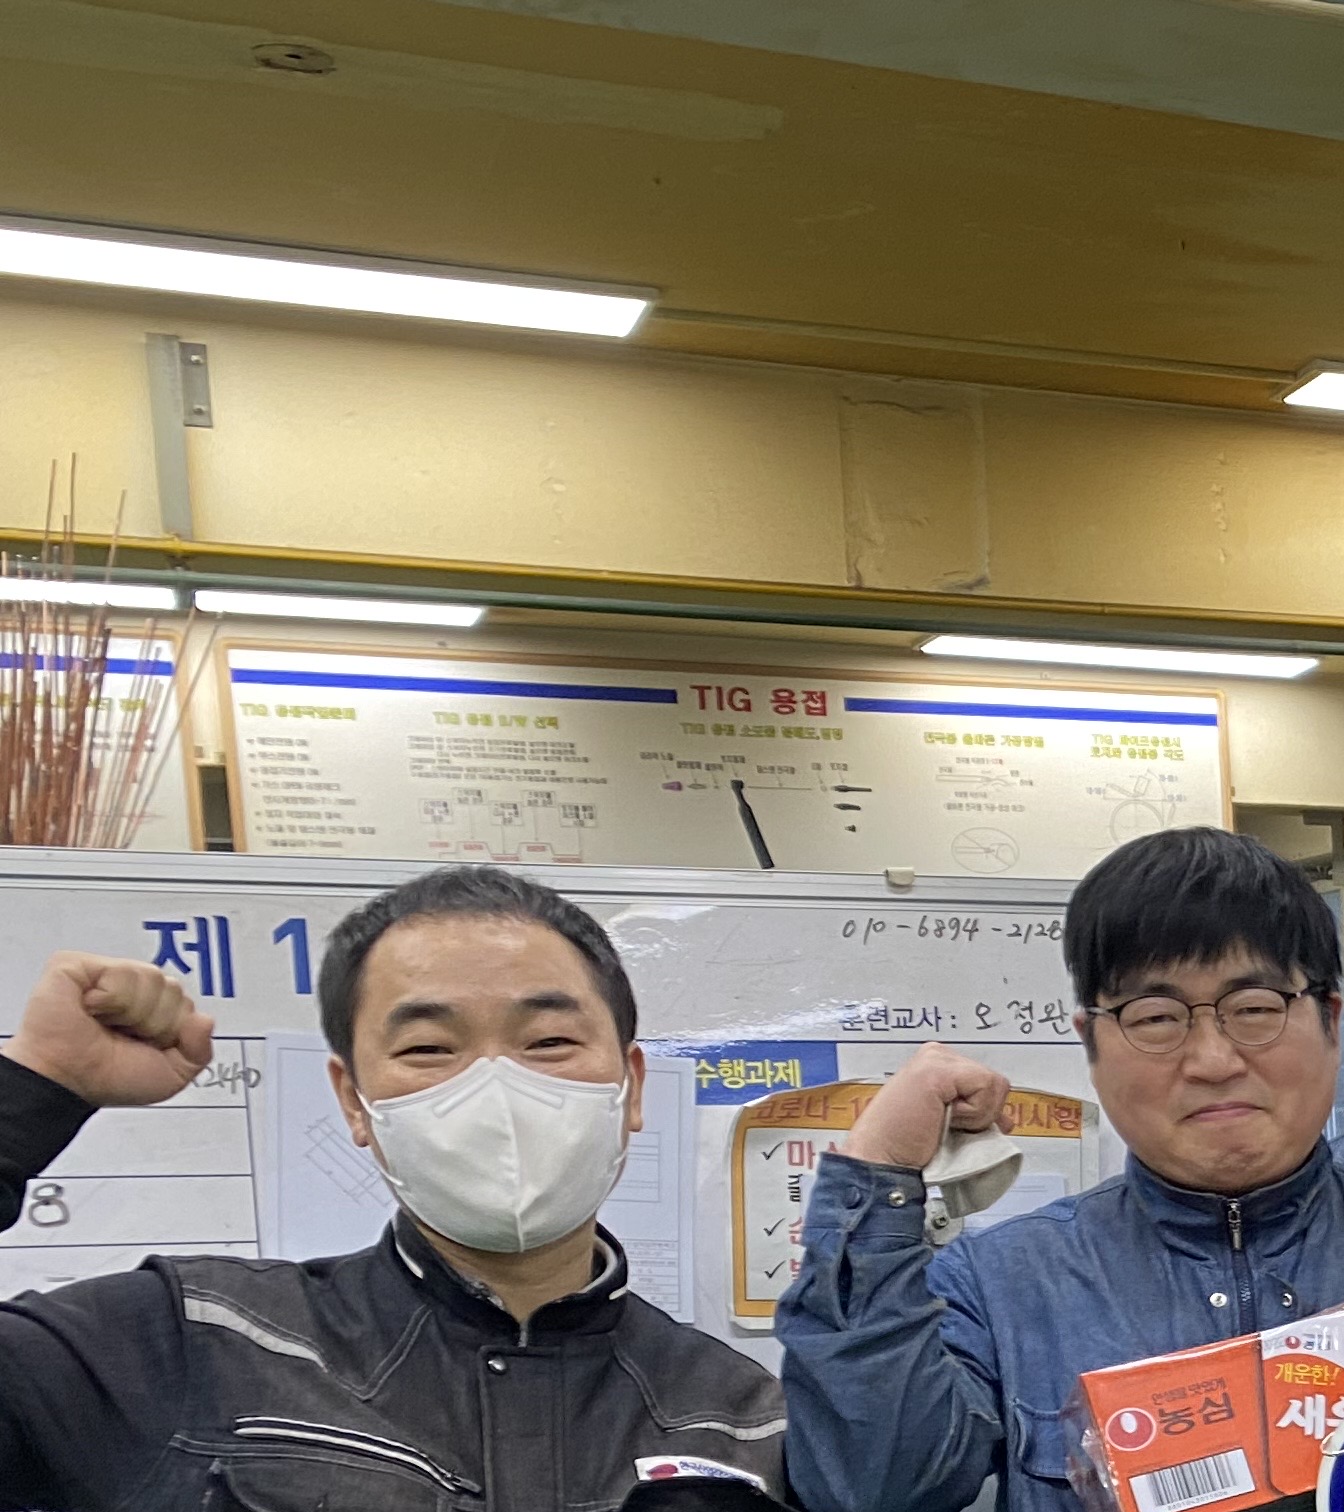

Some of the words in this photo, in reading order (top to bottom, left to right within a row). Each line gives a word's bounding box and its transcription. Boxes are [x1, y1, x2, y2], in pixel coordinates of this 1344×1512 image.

[690, 685, 752, 712] TIG
[770, 688, 827, 716] 용접
[143, 915, 235, 998] 제
[696, 1059, 801, 1089] 수행과제
[751, 1094, 872, 1123] 코로나-1
[1003, 1101, 1083, 1132] 의사항
[1274, 1362, 1341, 1386] 개운한!
[1158, 1391, 1235, 1436] 농심
